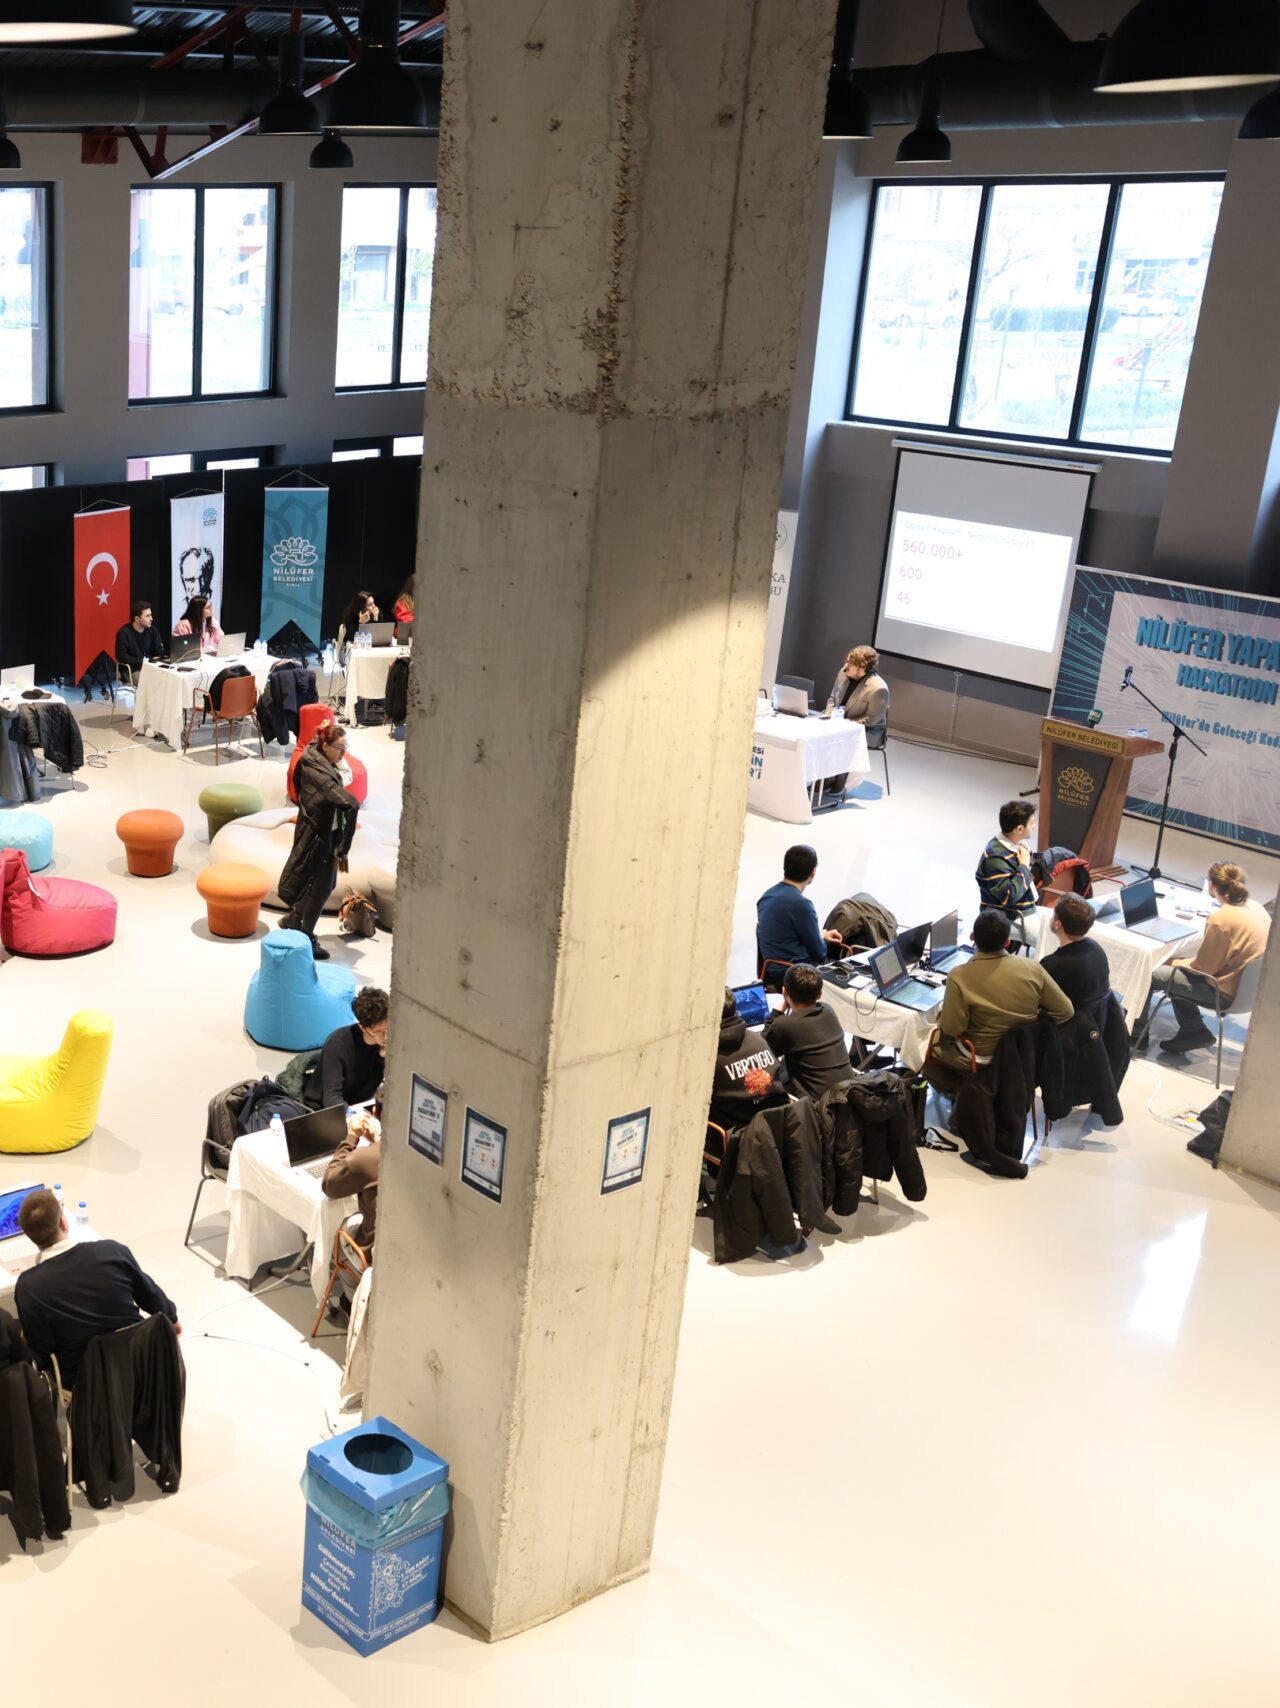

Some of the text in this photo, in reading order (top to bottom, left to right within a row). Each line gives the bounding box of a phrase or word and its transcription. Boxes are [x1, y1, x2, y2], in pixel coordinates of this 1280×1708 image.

[902, 539, 963, 560] 560.000+
[273, 566, 315, 575] NİLÜFER
[899, 565, 923, 580] 600
[896, 591, 912, 605] 46
[1136, 614, 1226, 661] NİLÜFER
[1176, 663, 1279, 706] HACKATHON
[1046, 726, 1119, 750] NİLÜFER BELEDİYESİ
[1212, 721, 1257, 745] Geleceği
[724, 1049, 775, 1081] VERTIGO
